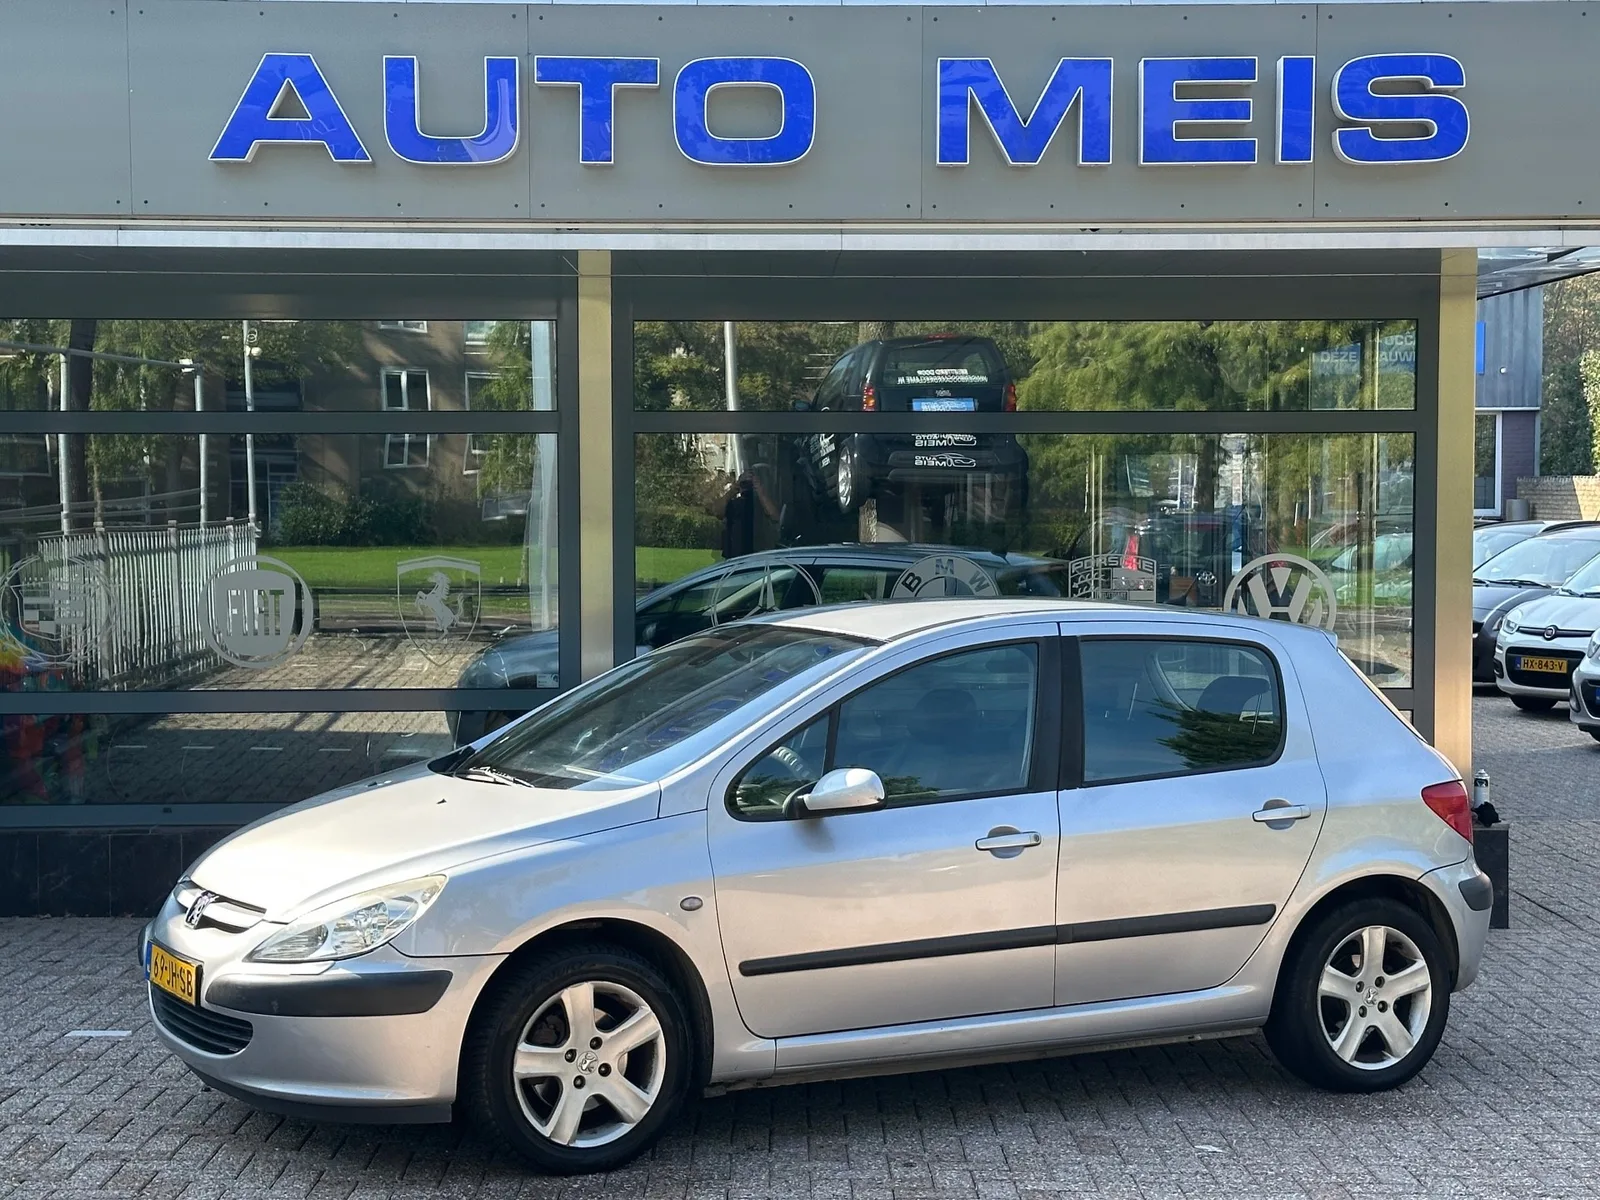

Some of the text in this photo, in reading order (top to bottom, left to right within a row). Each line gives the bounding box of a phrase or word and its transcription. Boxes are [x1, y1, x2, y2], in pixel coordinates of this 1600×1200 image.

[208, 52, 1470, 167] AUTO MEIS
[1320, 351, 1357, 363] DEZE
[901, 558, 990, 593] BMW
[226, 589, 284, 637] FIAT
[1522, 659, 1564, 671] HX-843-V
[153, 952, 193, 997] 69-JH-SB
